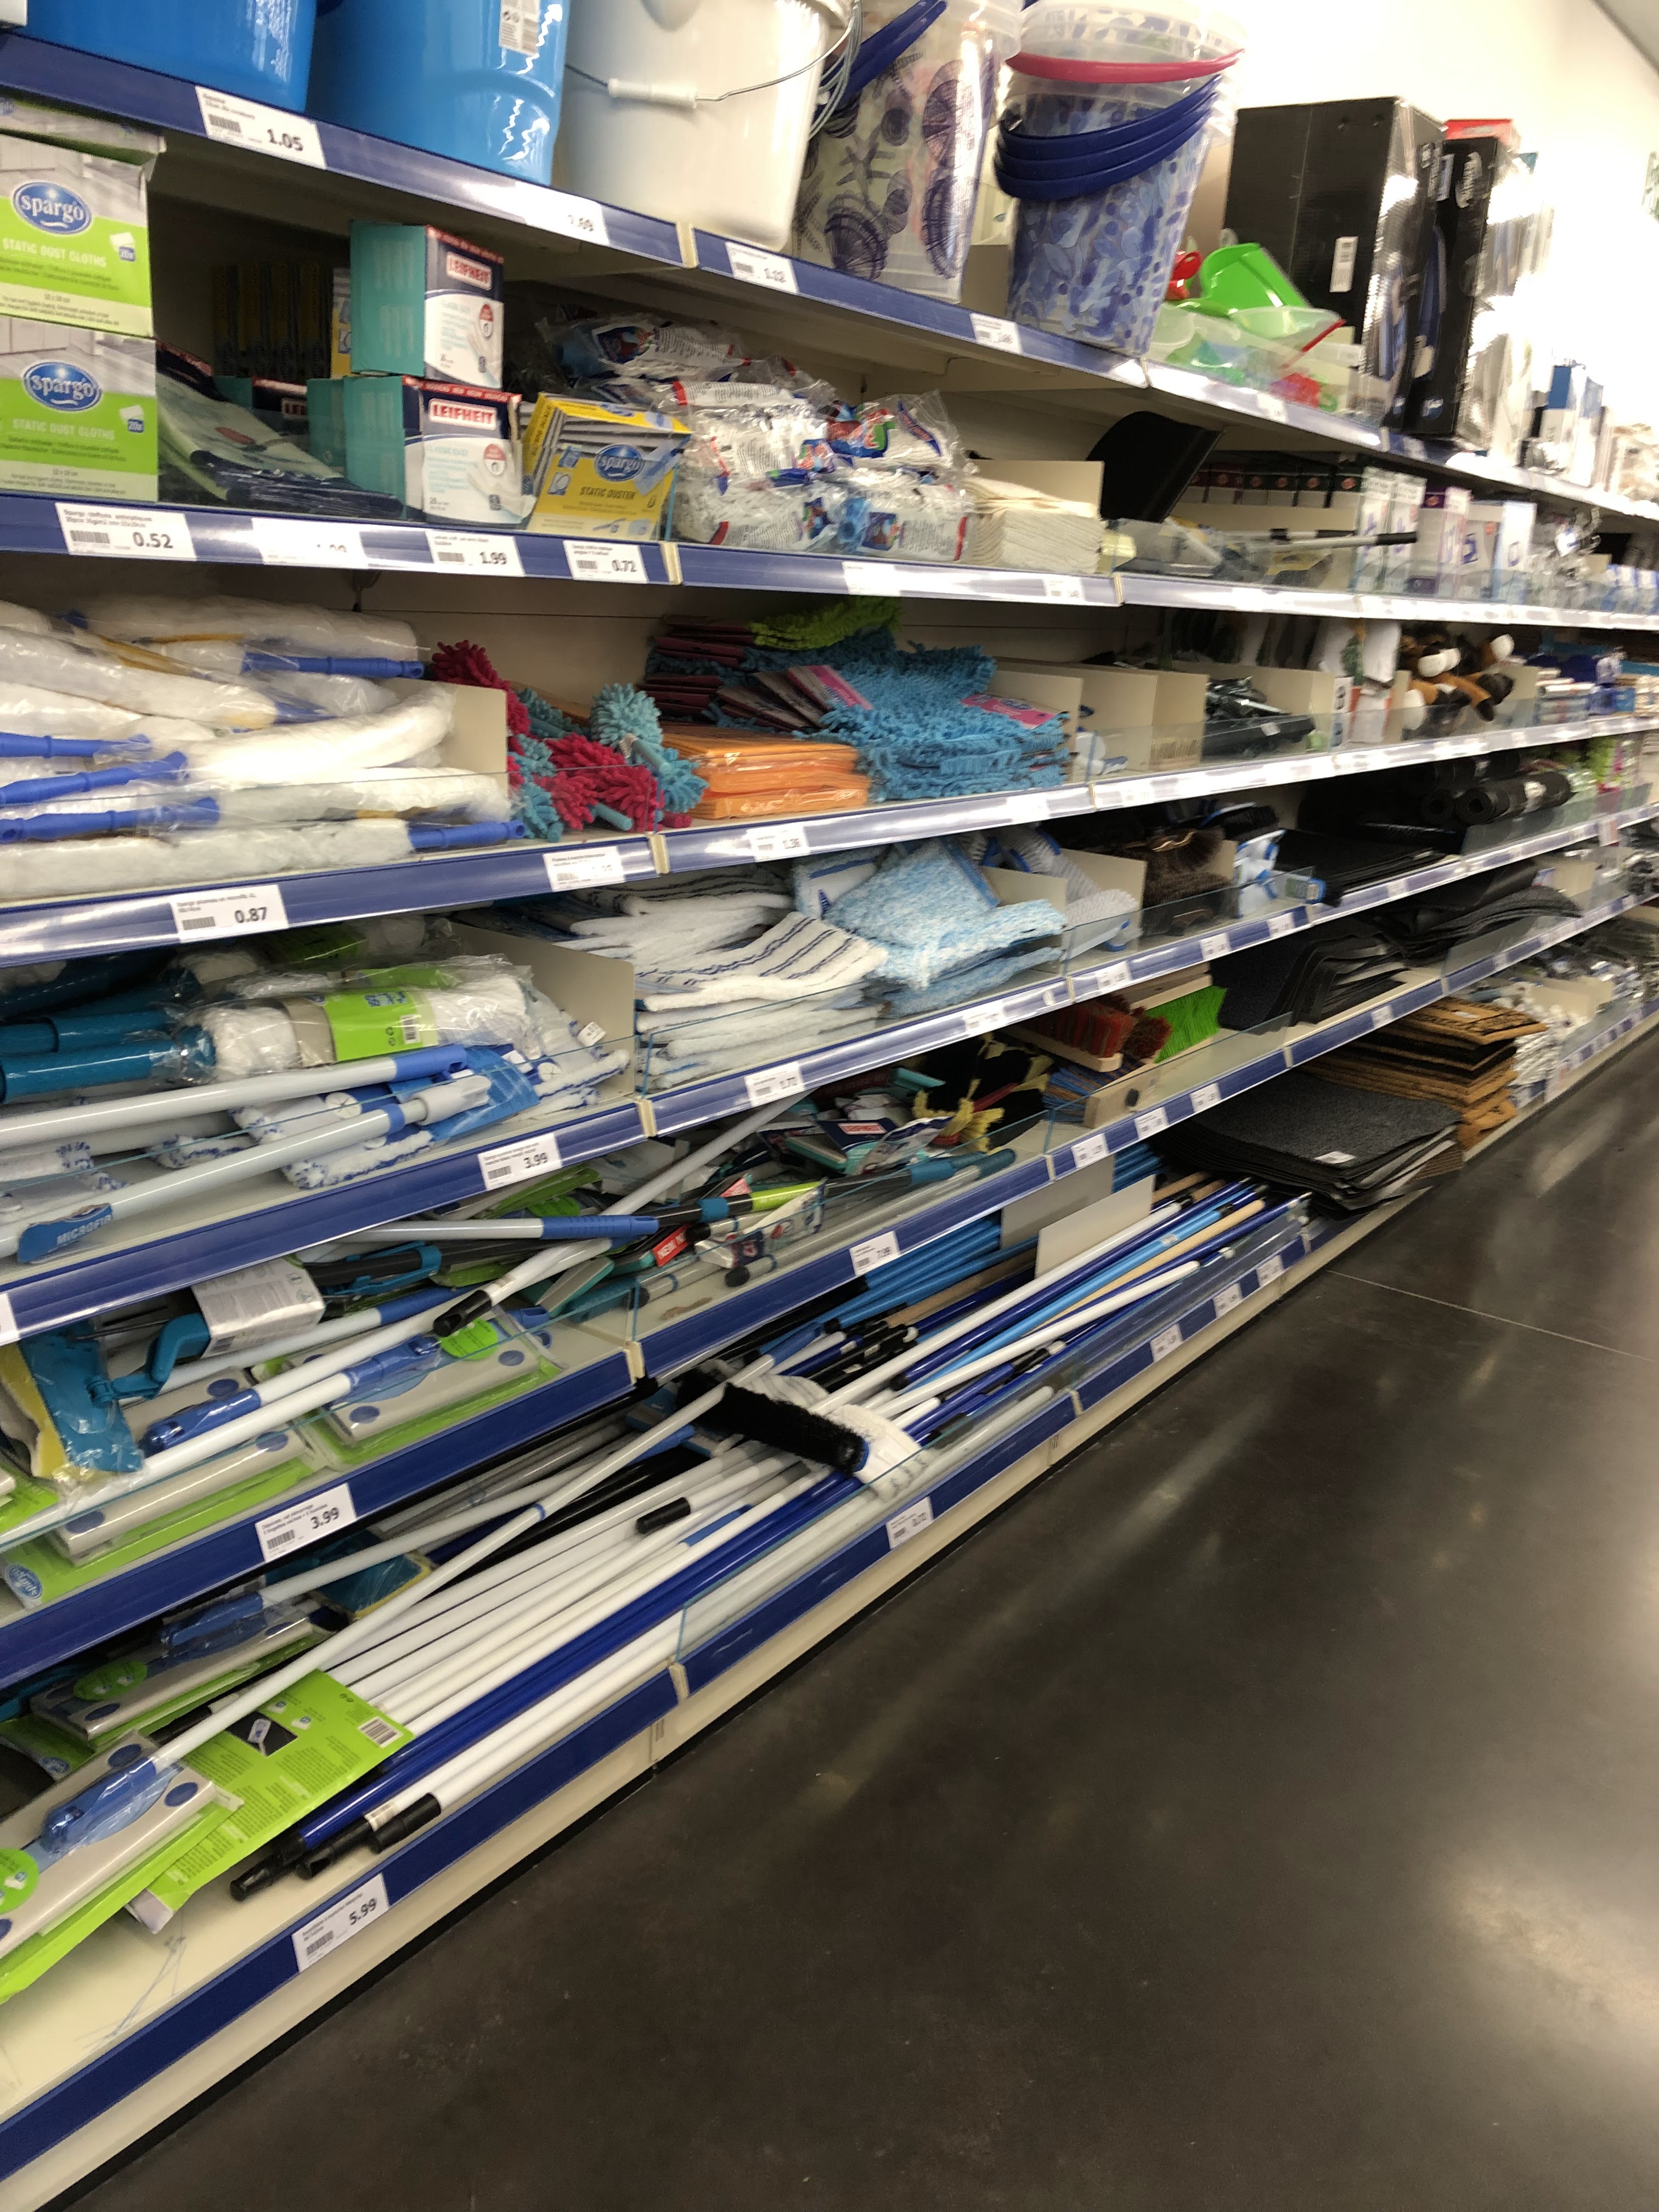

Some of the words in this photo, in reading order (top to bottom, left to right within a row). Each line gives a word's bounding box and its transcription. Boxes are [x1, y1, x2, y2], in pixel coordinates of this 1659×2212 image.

[267, 128, 303, 151] 1.05
[20, 194, 84, 223] spargo
[2, 238, 37, 255] STATIC
[40, 245, 66, 259] DUST
[69, 250, 107, 268] CLOTHS
[30, 375, 97, 400] spargo
[433, 404, 493, 425] LEIFHEIT
[13, 417, 48, 432] STATIC
[49, 423, 75, 435] DUST
[78, 426, 115, 440] CLOTHS
[579, 486, 607, 498] STATIC
[607, 489, 636, 500] DUSTER
[132, 531, 174, 549] 0.52
[479, 551, 508, 566] 1.99
[611, 559, 637, 573] 0.72
[234, 906, 268, 923] 0.87
[523, 1152, 548, 1169] 3.99
[310, 1506, 340, 1530] 3.99
[349, 1898, 378, 1926] 5.99
